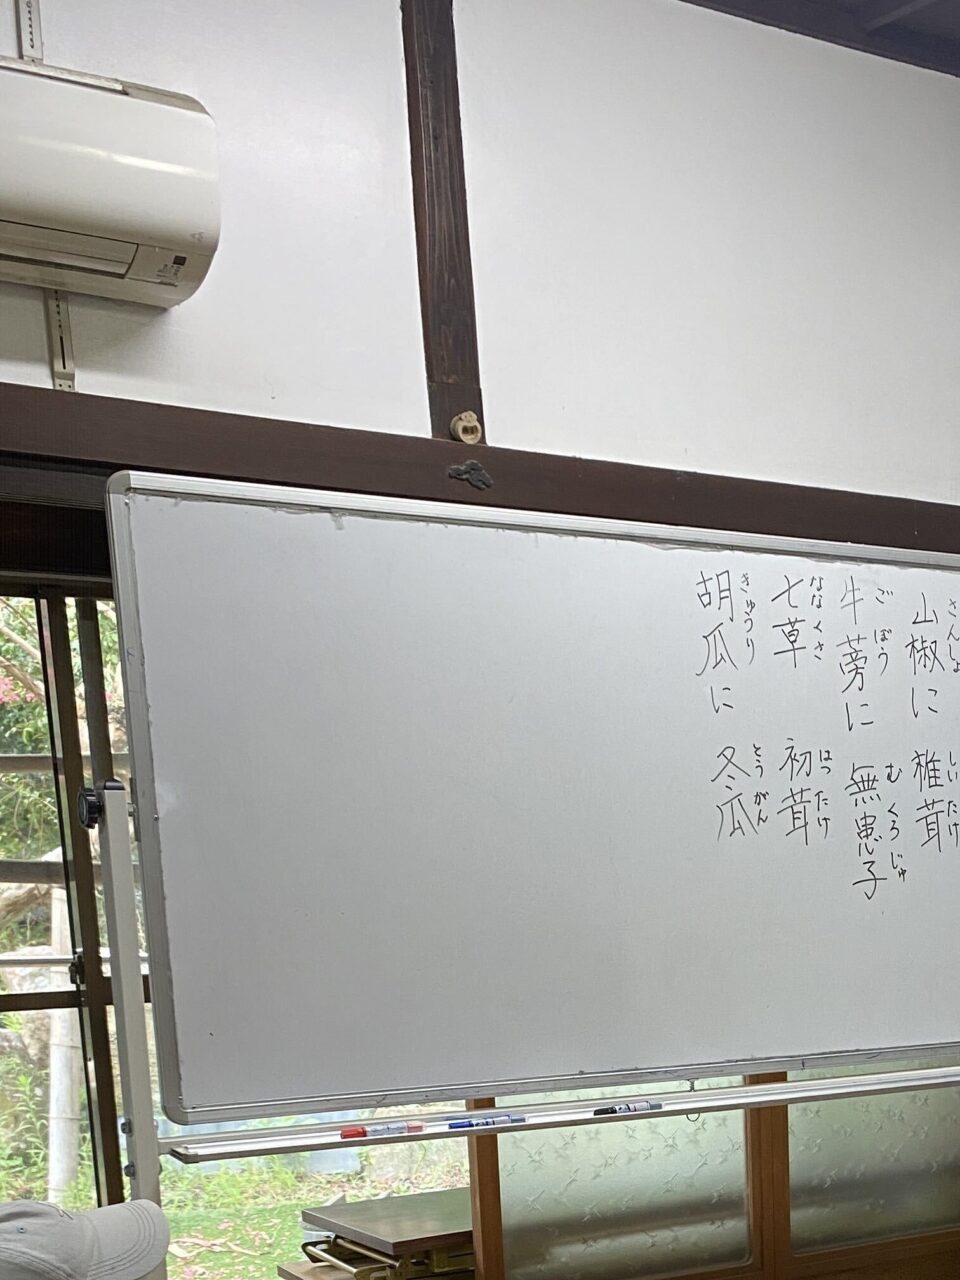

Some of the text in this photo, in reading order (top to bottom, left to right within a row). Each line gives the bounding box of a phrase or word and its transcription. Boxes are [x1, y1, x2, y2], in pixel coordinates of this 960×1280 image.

[740, 573, 756, 666] きゅうり
[809, 576, 825, 661] ななくさ
[905, 592, 946, 718] 山椒に
[696, 570, 760, 842] 胡瓜に 冬瓜
[771, 574, 812, 846] 七草 初茸
[836, 576, 889, 901] 牛蒡に 無患子
[947, 750, 960, 848] しいたけ
